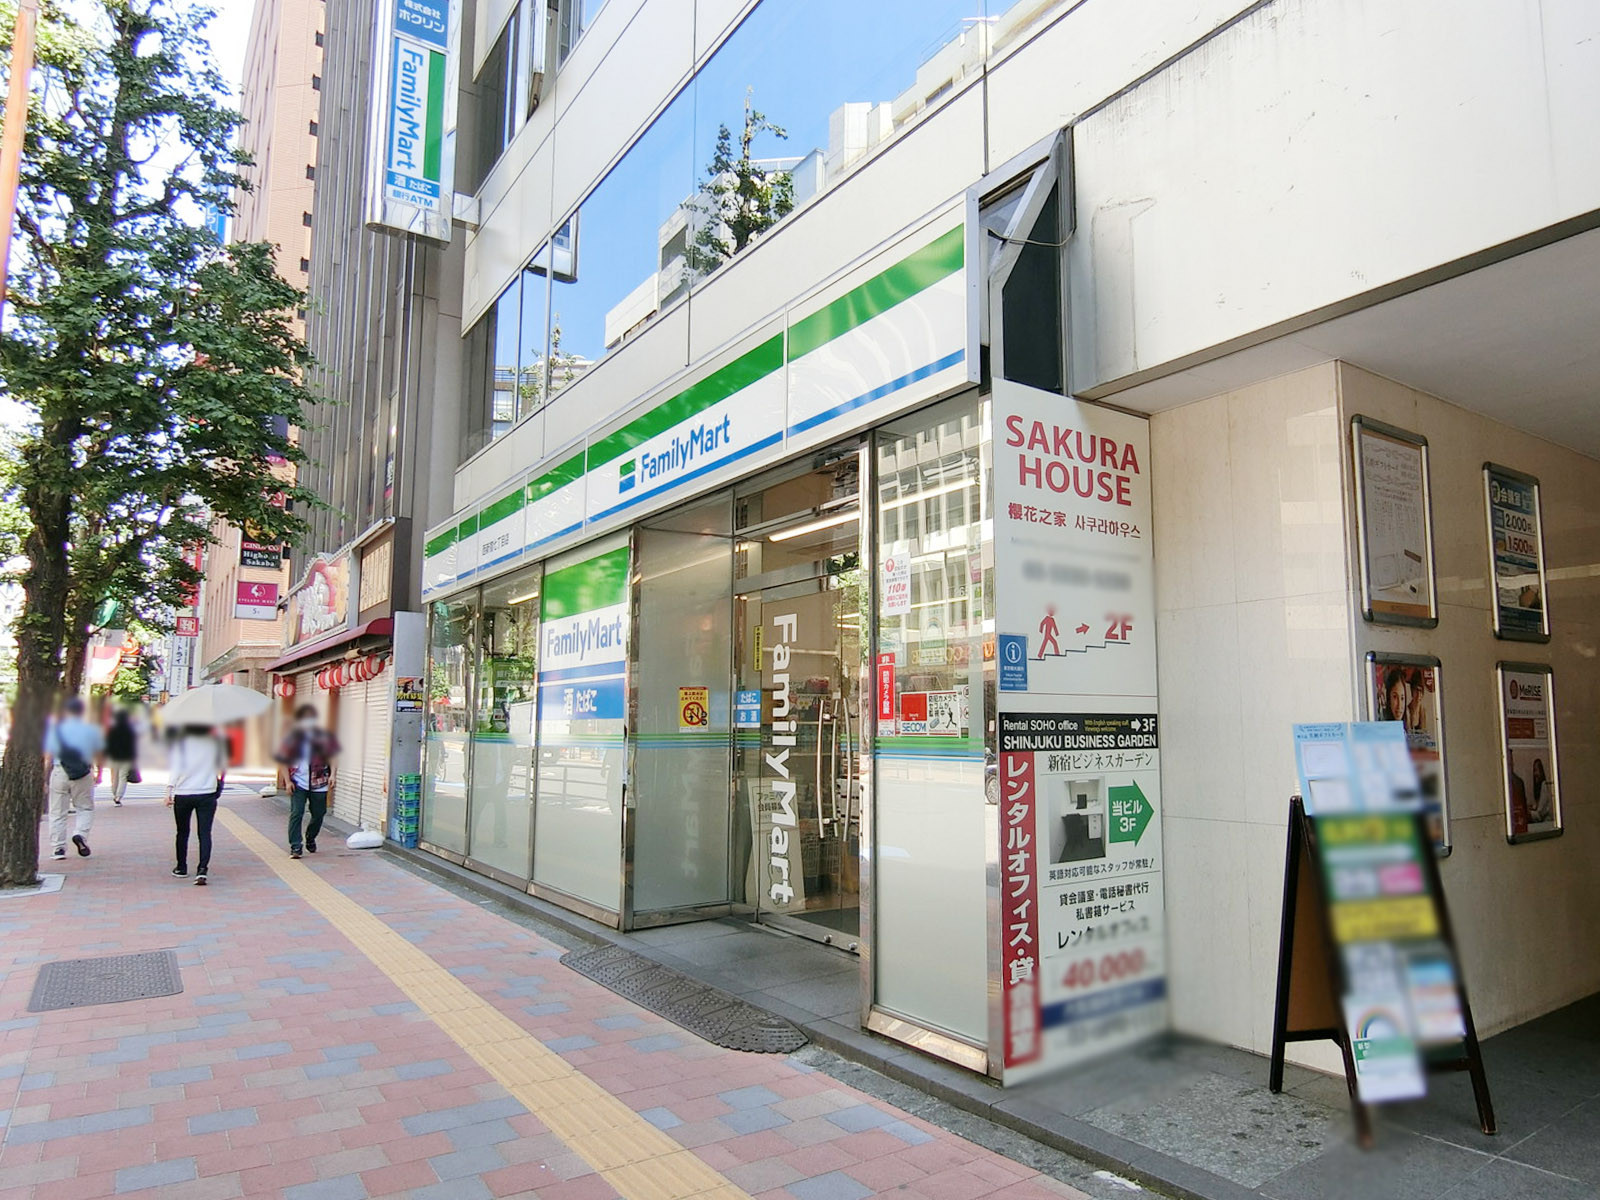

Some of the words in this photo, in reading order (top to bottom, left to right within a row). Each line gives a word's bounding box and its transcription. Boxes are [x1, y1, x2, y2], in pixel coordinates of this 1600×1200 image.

[396, 47, 424, 170] FamilyMart
[409, 179, 433, 195] たばこ
[640, 412, 731, 484] FamilyMart
[1005, 413, 1141, 476] SAKURA
[1018, 453, 1133, 507] HOUSE
[1007, 502, 1067, 528] 櫻花之家
[1074, 514, 1142, 539] 사쿠라하우스
[246, 559, 275, 567] Sakaba
[546, 615, 622, 660] FamilyMart
[1104, 612, 1134, 640] 2F
[576, 688, 598, 713] たばこ
[740, 692, 758, 703] たばこ
[901, 722, 927, 732] SECOM
[1003, 719, 1029, 731] Rental
[1030, 719, 1056, 731] SOHO
[1057, 719, 1079, 731] office
[1142, 718, 1156, 732] 3F
[1003, 734, 1062, 750] SHINJUKU
[1064, 734, 1116, 749] BUSINESS
[1117, 733, 1157, 747] GARDEN
[765, 613, 798, 904] FamilyMart
[1047, 751, 1154, 772] 新宿ビジネスガーデン
[1111, 800, 1143, 816] 当ビル
[1119, 816, 1137, 832] 3F
[1059, 881, 1150, 907] 貸会議室・電話秘書代行
[1075, 900, 1136, 920] 私書箱サービス
